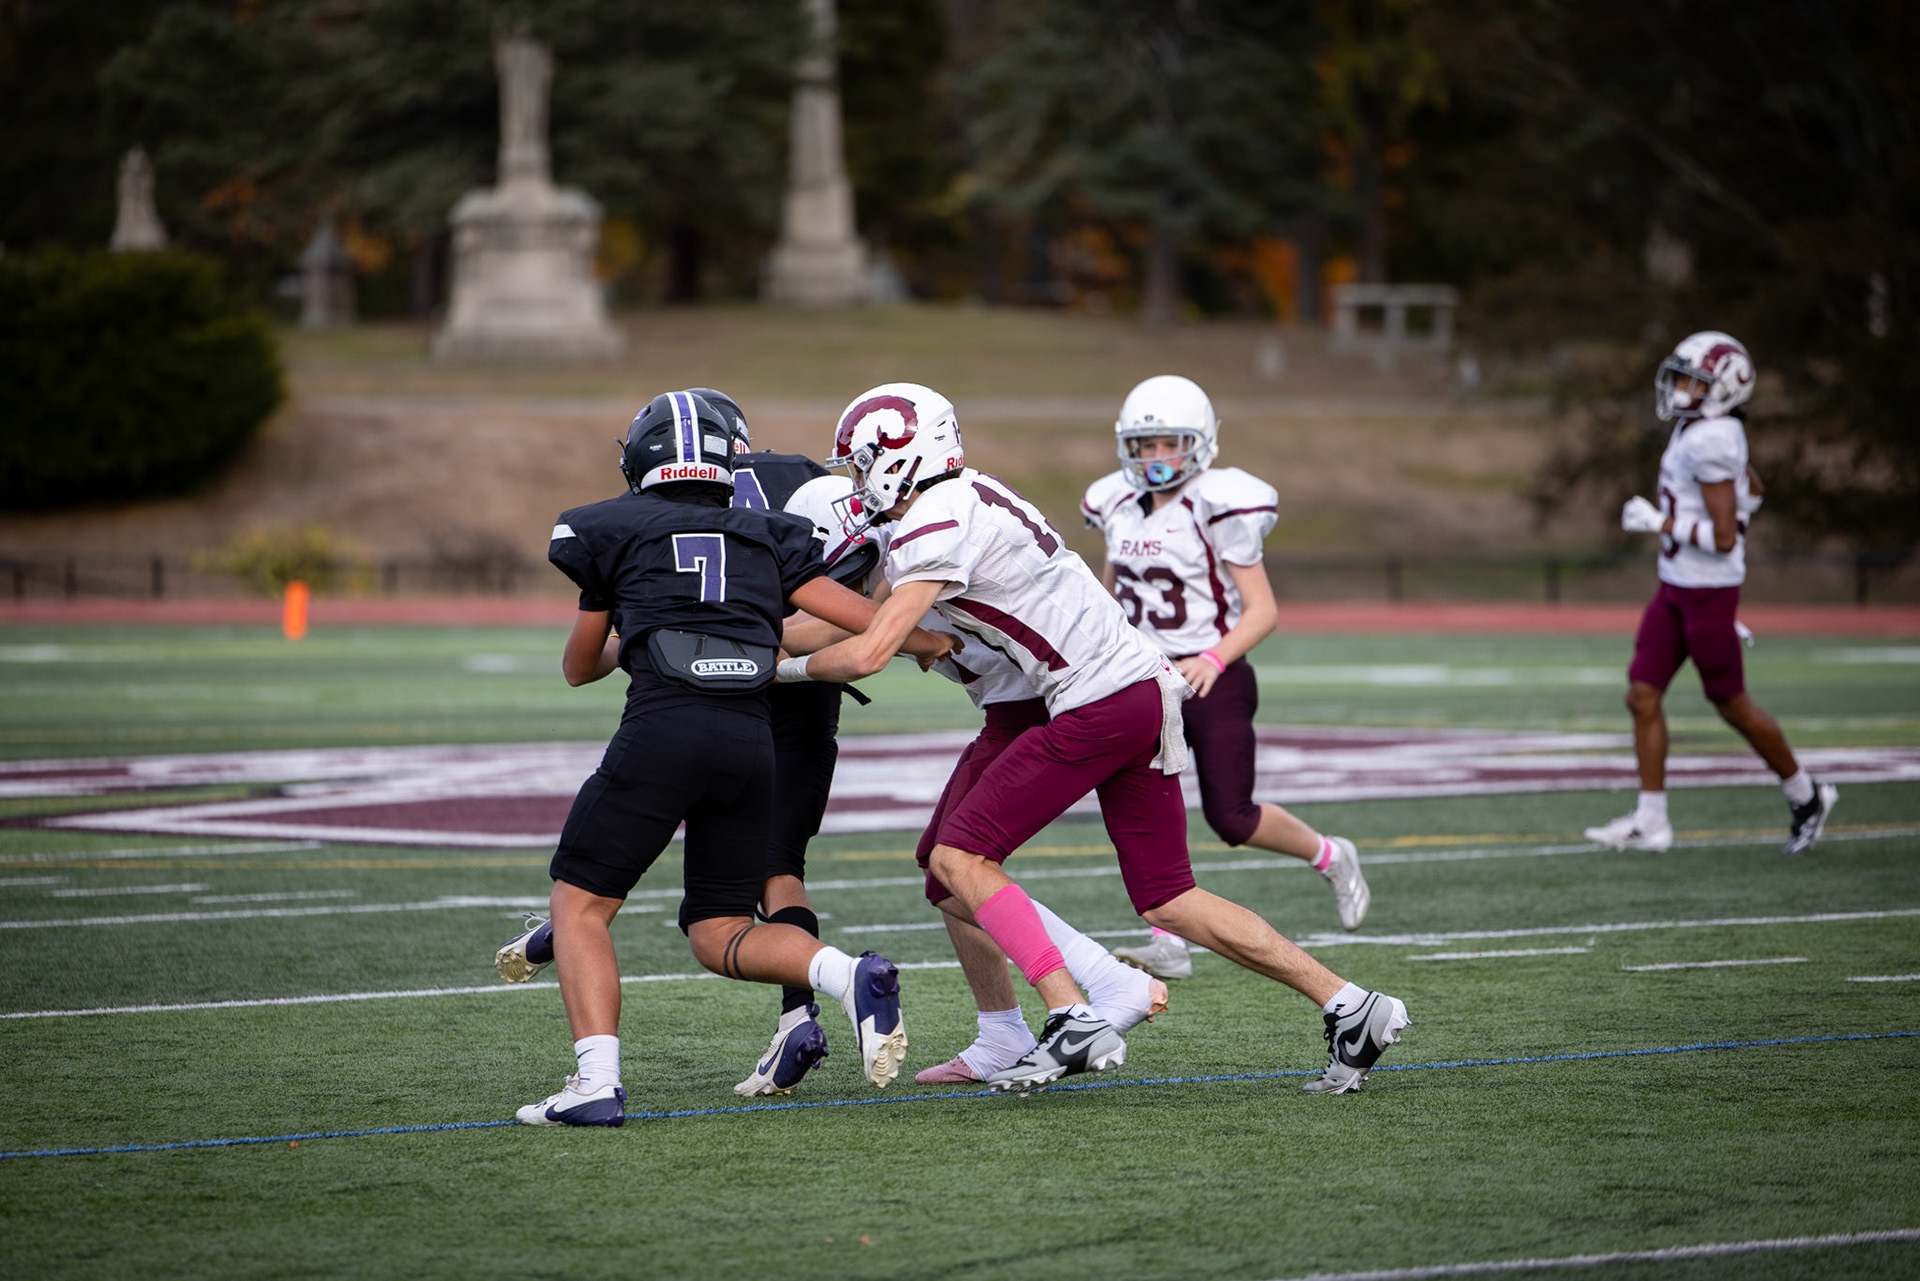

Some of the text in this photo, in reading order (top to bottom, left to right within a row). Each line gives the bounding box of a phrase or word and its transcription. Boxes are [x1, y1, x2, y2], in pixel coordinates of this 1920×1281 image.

[660, 465, 718, 481] Riddell
[1119, 539, 1162, 557] RAMS
[671, 533, 727, 603] 7
[697, 661, 753, 673] BATTLE
